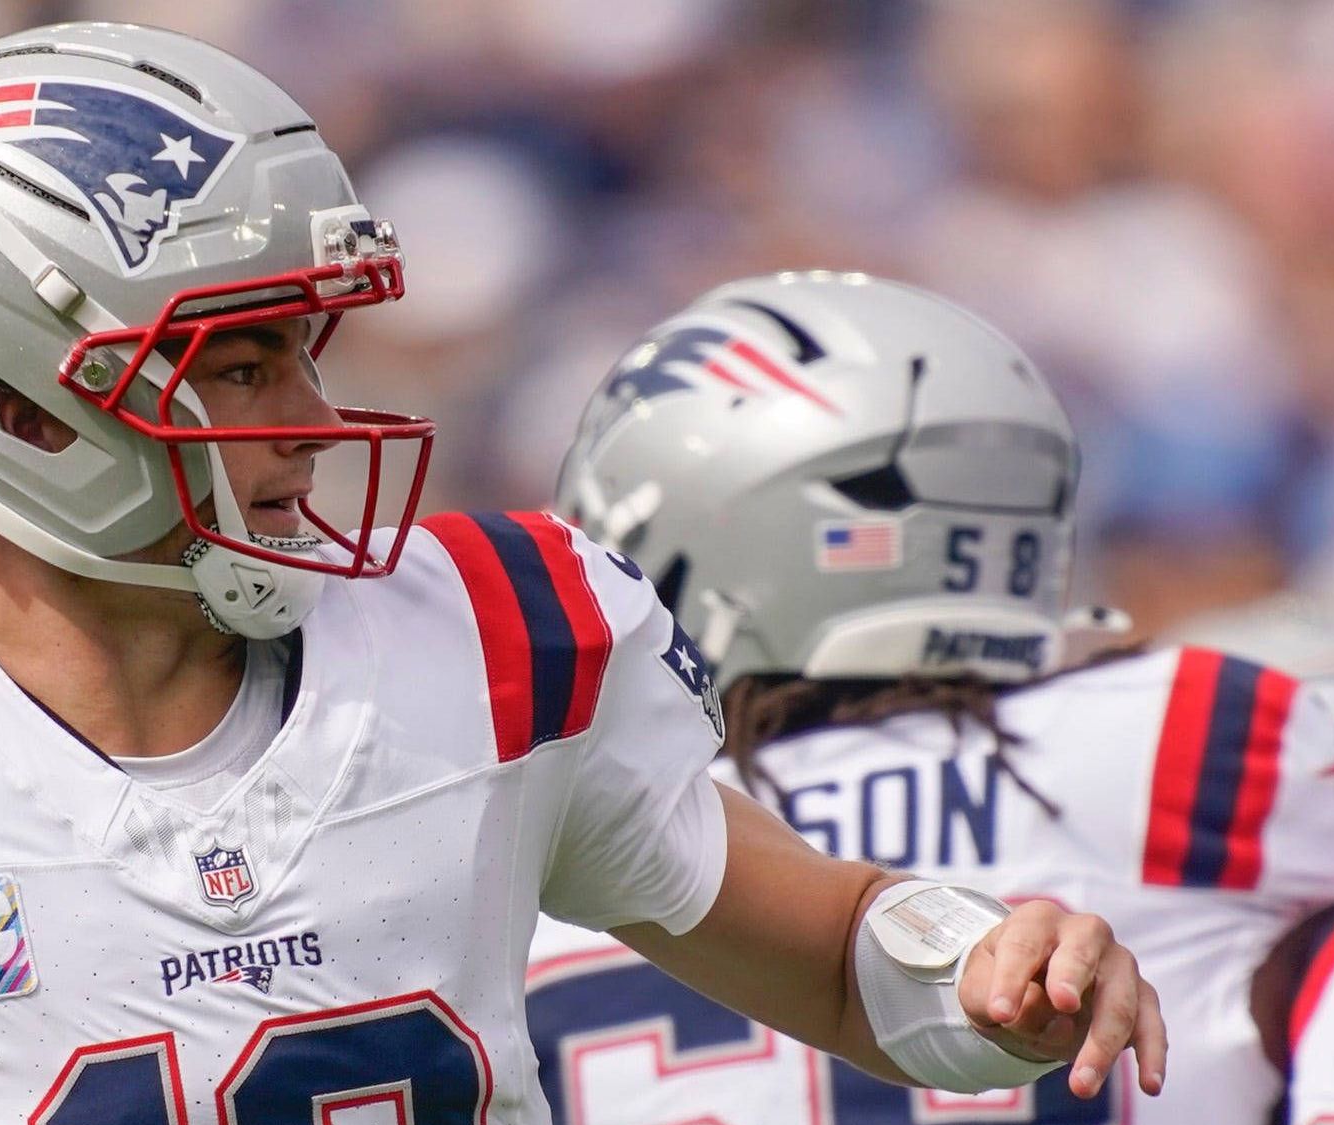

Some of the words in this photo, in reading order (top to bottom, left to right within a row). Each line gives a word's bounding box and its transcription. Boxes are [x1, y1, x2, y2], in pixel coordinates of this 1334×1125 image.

[941, 526, 1042, 597] 58
[204, 868, 250, 897] NFL
[160, 932, 323, 996] PATRIOTS
